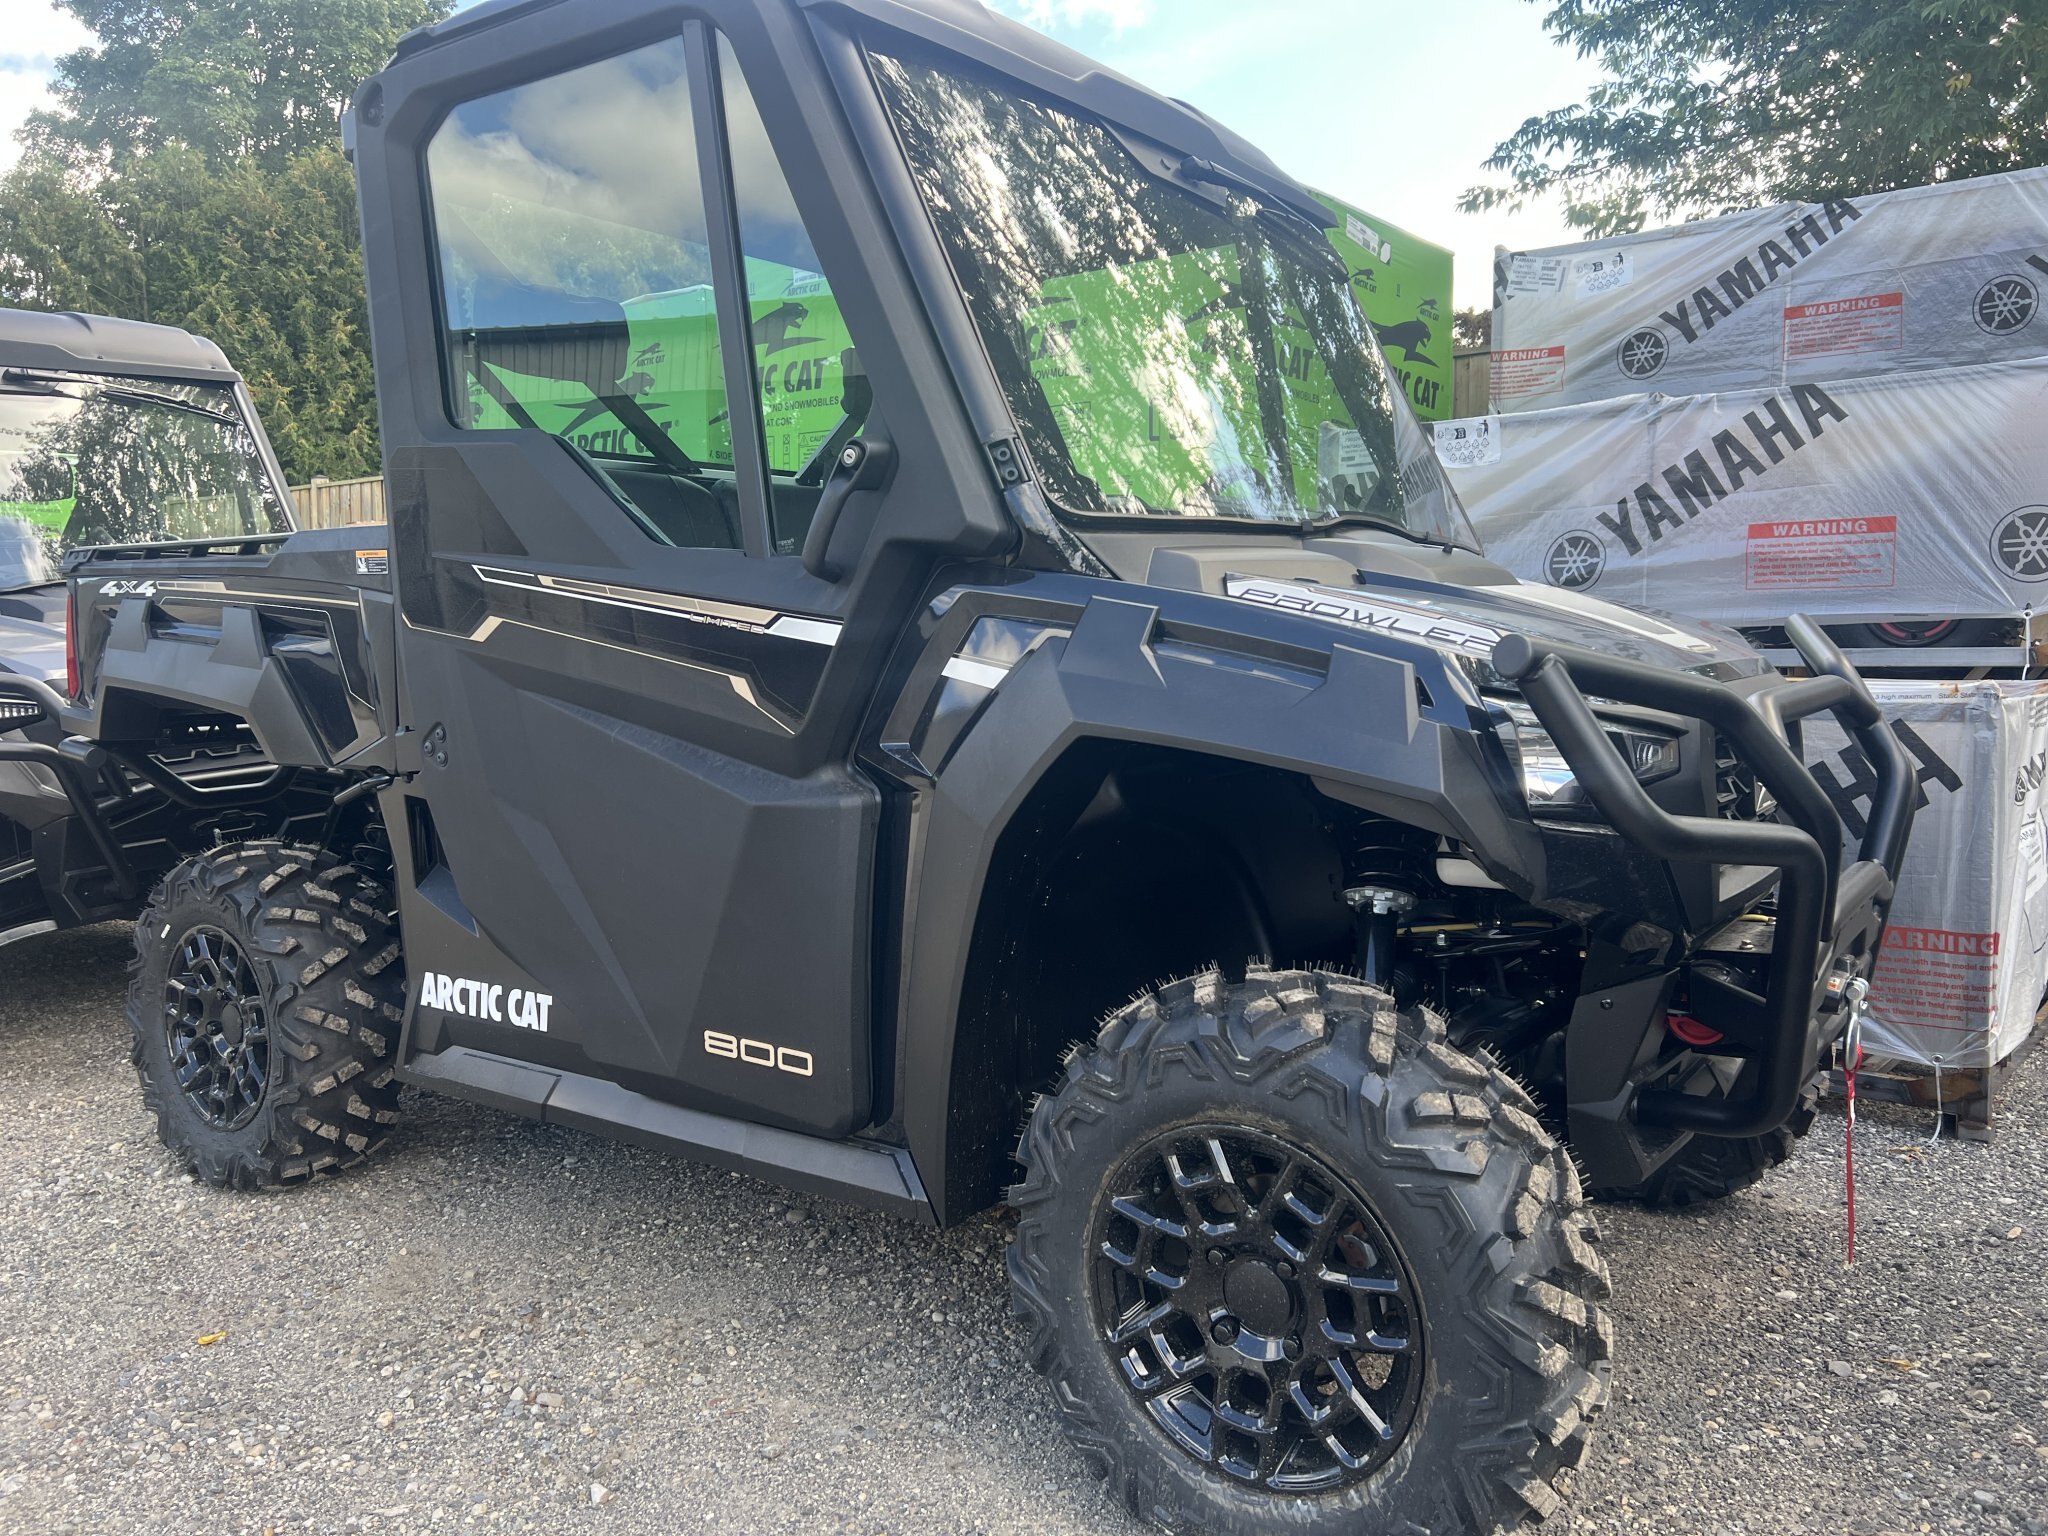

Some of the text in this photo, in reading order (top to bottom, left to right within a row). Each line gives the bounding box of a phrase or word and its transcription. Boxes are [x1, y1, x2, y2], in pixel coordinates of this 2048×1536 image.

[1659, 198, 1863, 345] YAMAHA
[787, 283, 821, 297] ARCTIC CAT
[1353, 277, 1377, 294] ARCTIC CAT
[1804, 297, 1880, 316] WARNING
[636, 354, 665, 367] ARCTIC CAT
[1491, 349, 1549, 362] WARNING
[784, 357, 828, 393] CAT
[1414, 375, 1440, 410] CAT
[785, 395, 840, 411] SNOWMOBILES
[715, 450, 733, 462] SIDE
[1596, 383, 1849, 557] YAMAHA
[1772, 519, 1868, 537] WARNING
[689, 613, 765, 635] LIMITED
[1886, 929, 1995, 955] ARNING
[1899, 967, 1931, 976] stacked
[1933, 971, 1965, 981] securely
[420, 971, 553, 1032] ARCTIC CAT
[1942, 992, 1961, 1000] ANSI
[703, 1030, 813, 1077] 800
